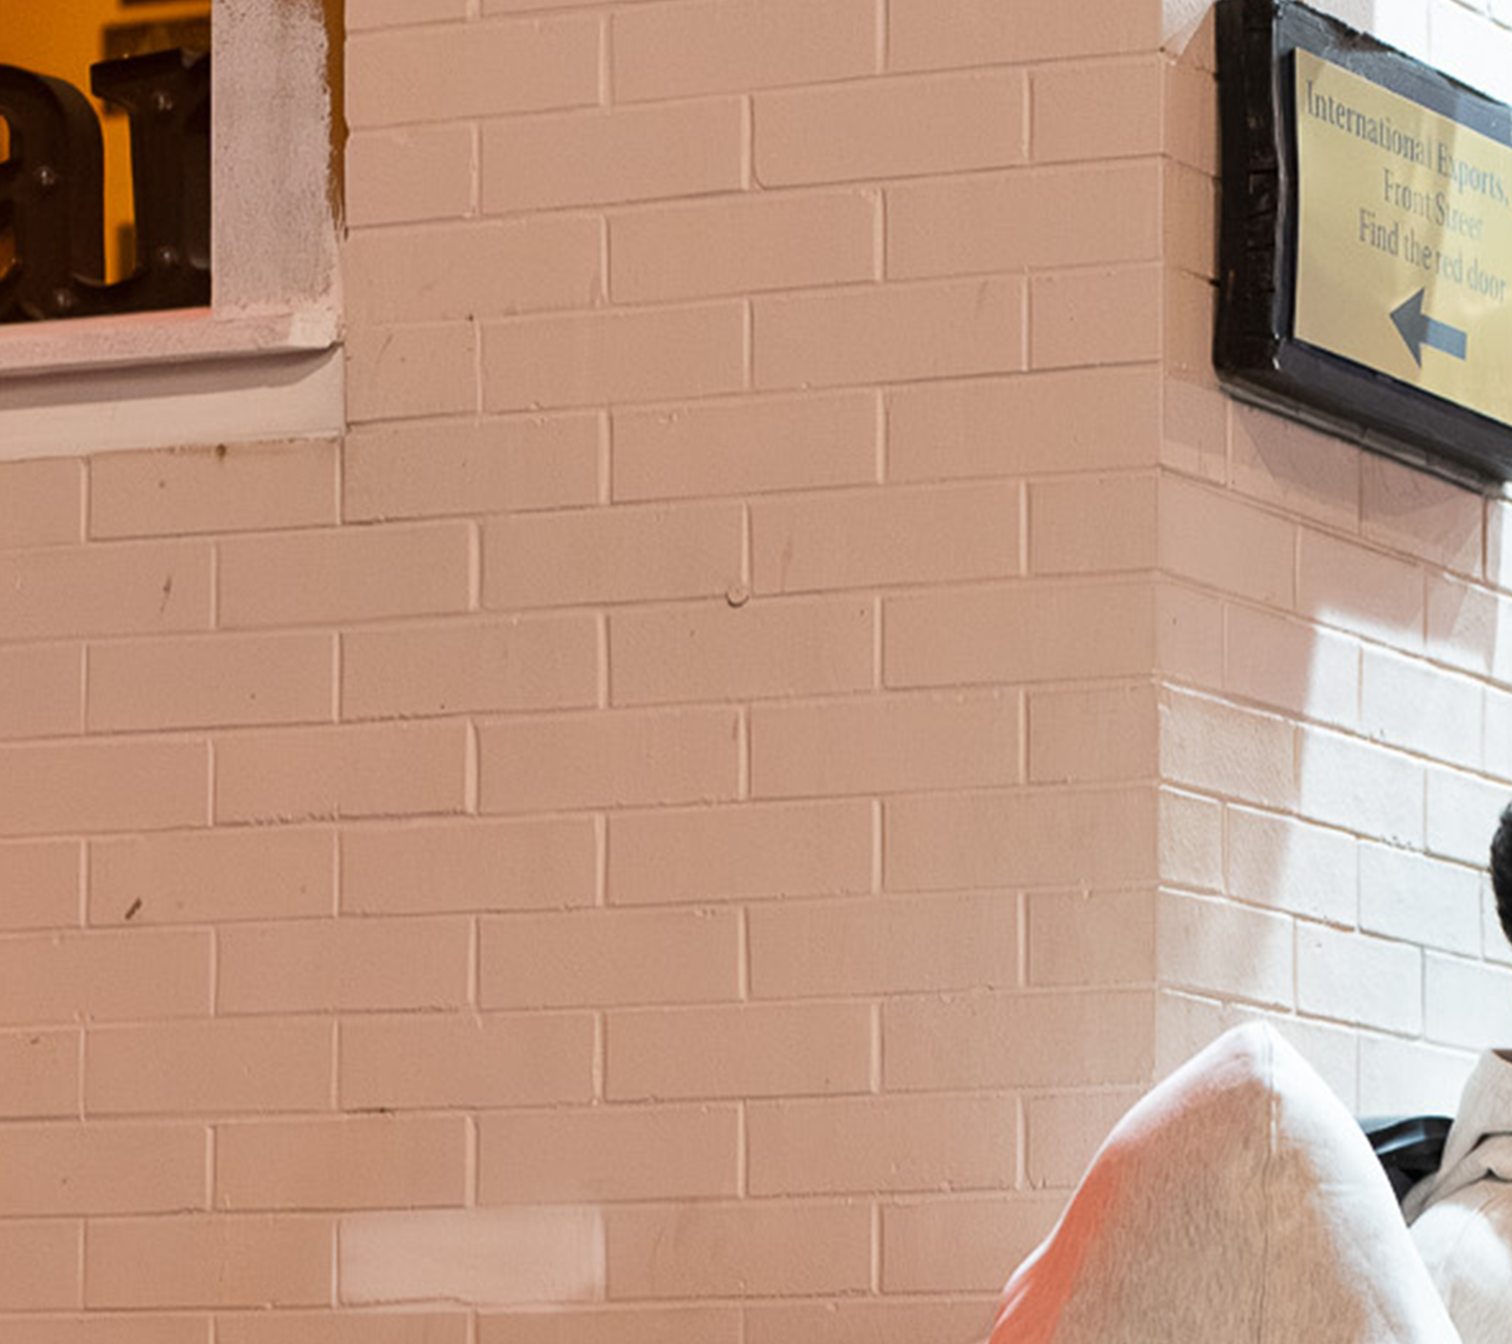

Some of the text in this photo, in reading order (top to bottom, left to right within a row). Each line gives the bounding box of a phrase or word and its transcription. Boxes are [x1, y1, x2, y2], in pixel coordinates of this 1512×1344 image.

[1306, 79, 1433, 170] International
[1438, 143, 1510, 208] Exports,
[1383, 167, 1485, 241] Front Street
[1358, 208, 1508, 303] Find the red door
